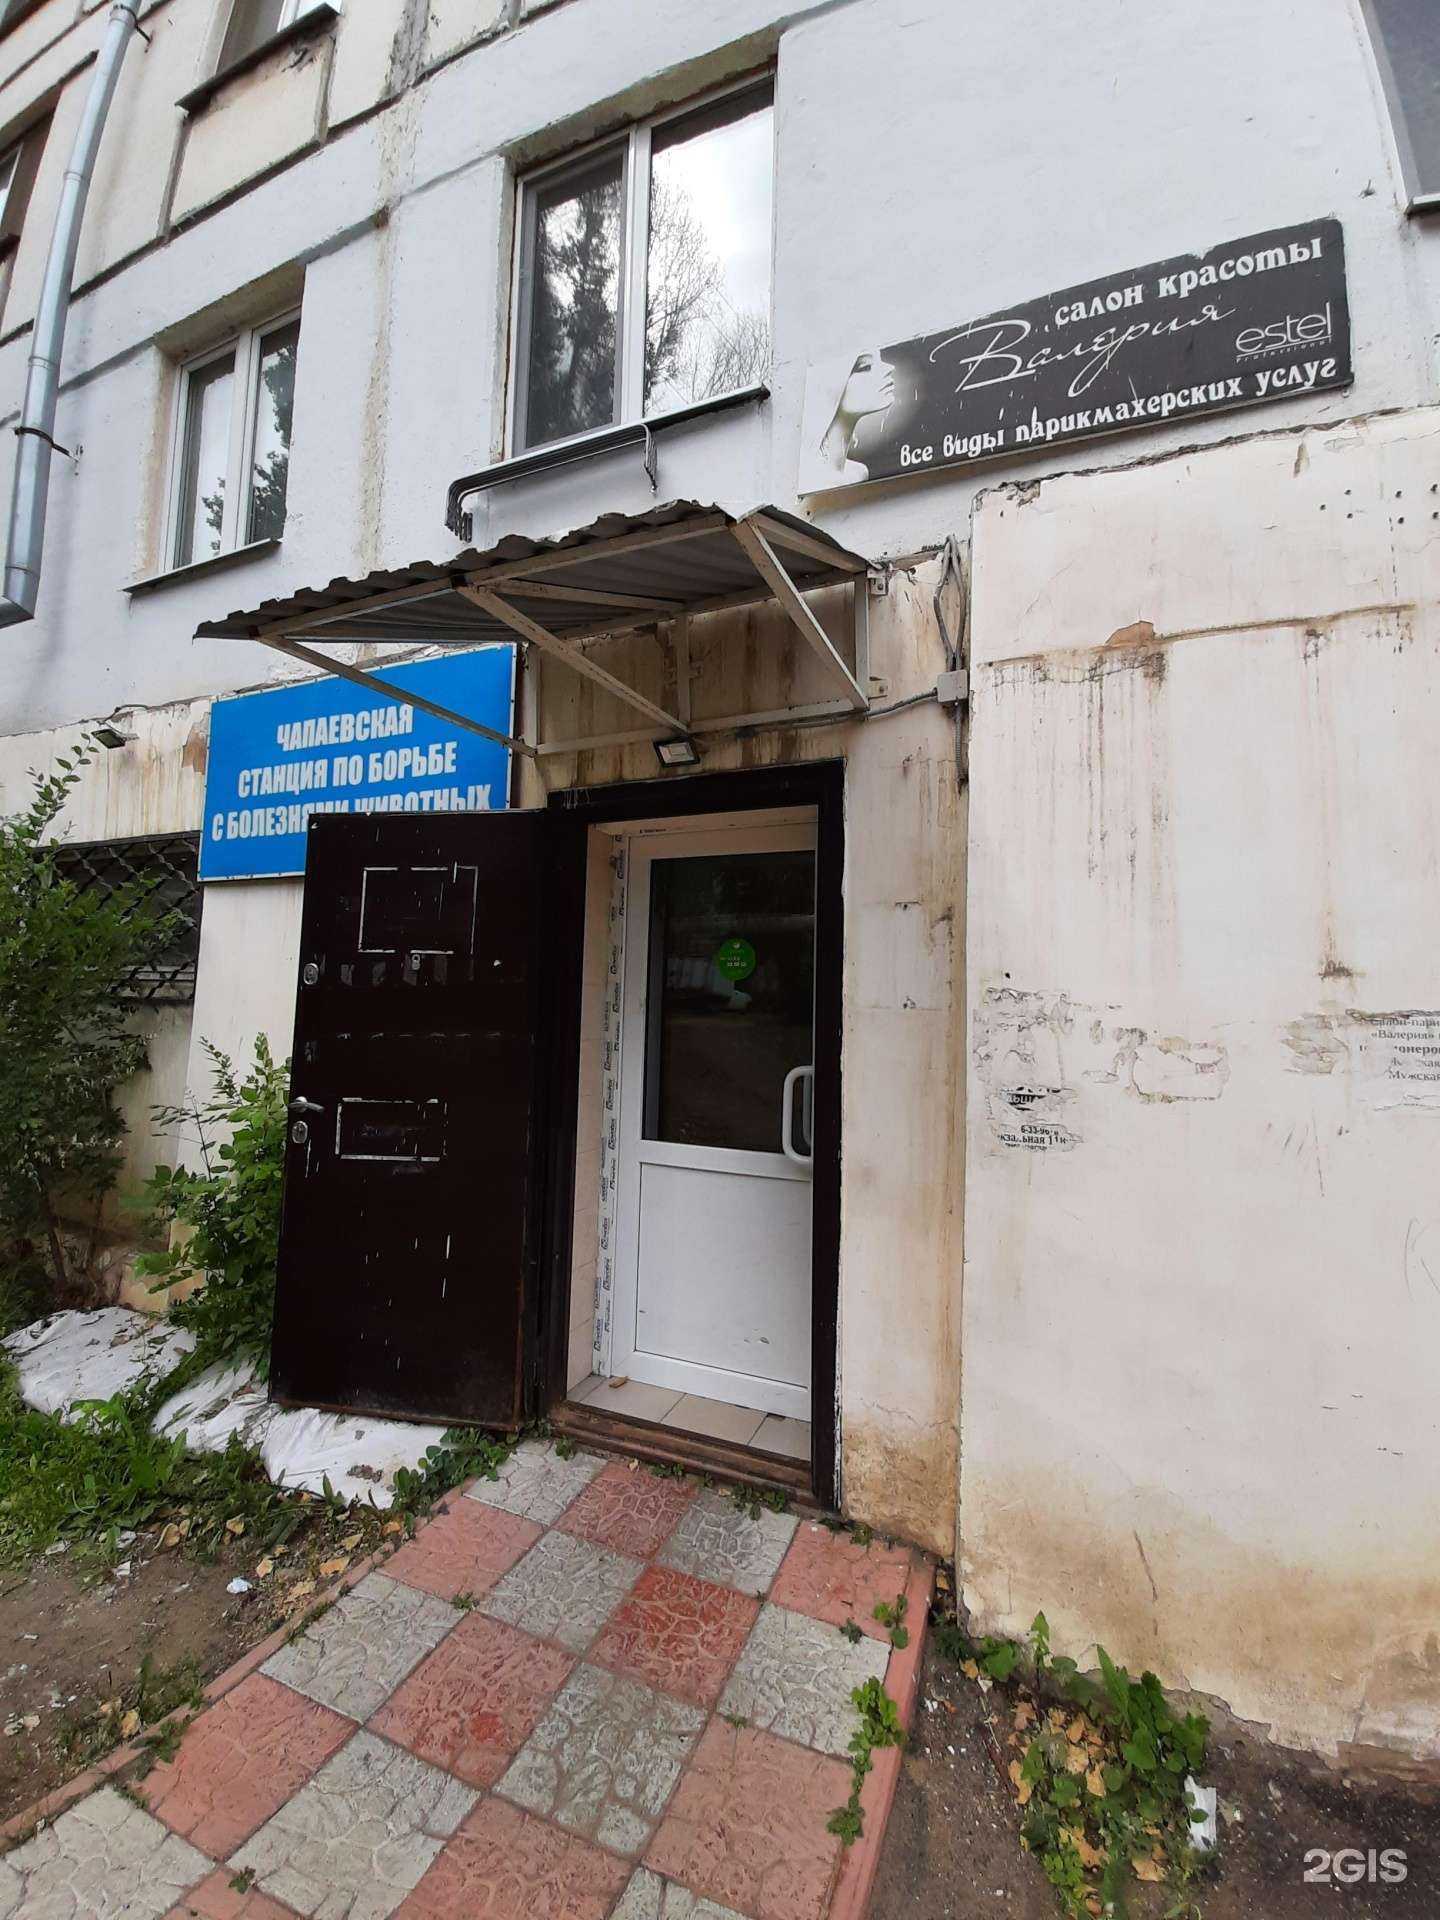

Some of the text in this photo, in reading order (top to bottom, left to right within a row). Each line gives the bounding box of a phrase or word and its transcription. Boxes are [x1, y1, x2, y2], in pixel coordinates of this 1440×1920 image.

[1054, 237, 1323, 326] салон красоты
[929, 304, 1236, 398] Валерия
[1235, 301, 1333, 353] estel
[900, 357, 1337, 467] все виды парикмахерских услуг
[277, 702, 414, 752] ЧАПАЕВСКАЯ
[238, 741, 458, 798] СТАНЦИЯ ПО БОРЬБЕ
[211, 813, 223, 842] С
